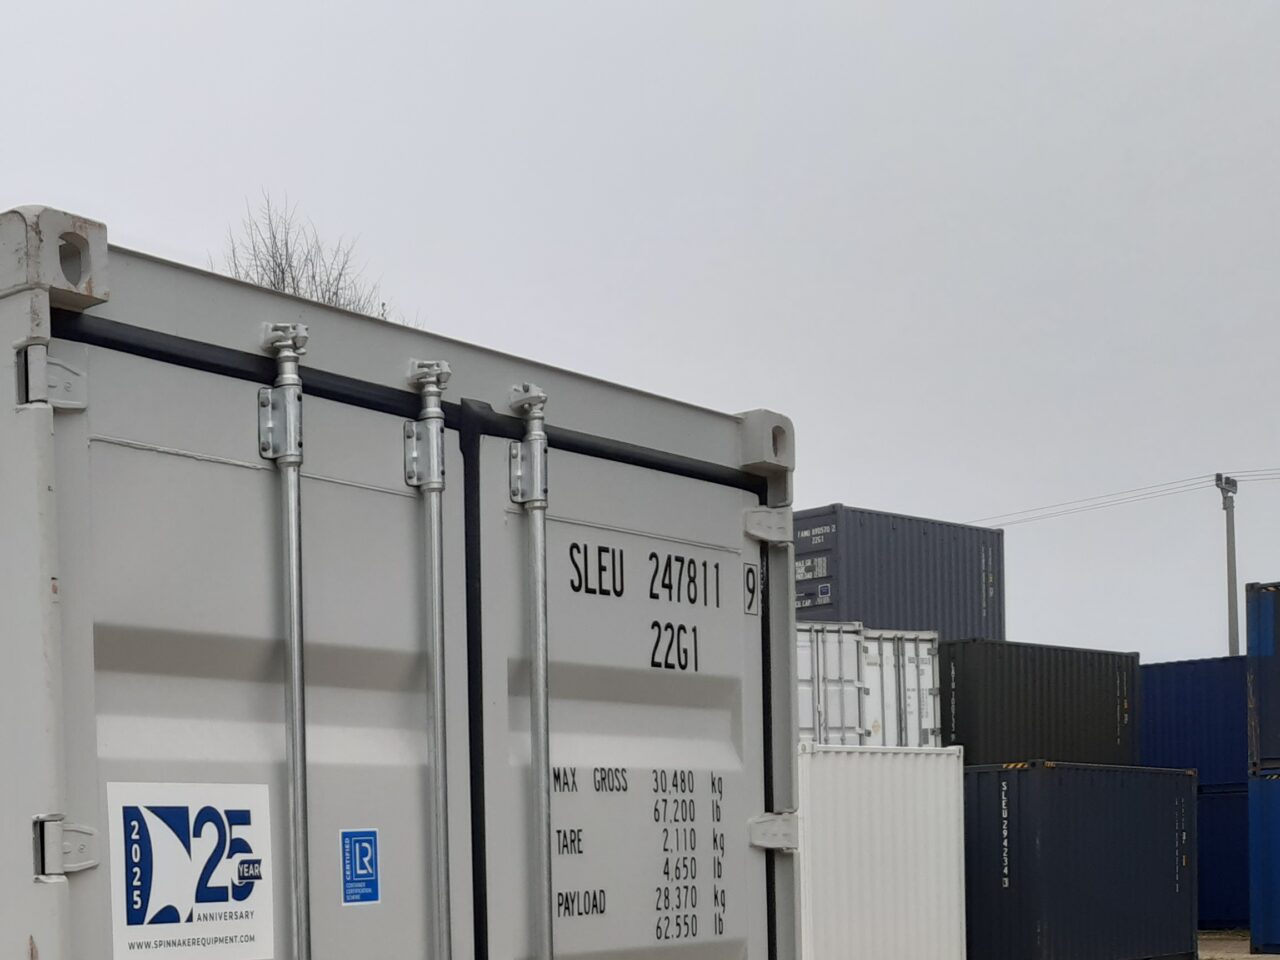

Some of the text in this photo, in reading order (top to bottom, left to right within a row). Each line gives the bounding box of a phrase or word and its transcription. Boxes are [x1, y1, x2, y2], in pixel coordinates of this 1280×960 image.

[570, 542, 624, 598] SLEU
[649, 552, 720, 608] 247811
[745, 566, 757, 613] 9
[650, 619, 699, 672] 22G1
[553, 767, 578, 792] MAX
[593, 767, 628, 792] GROSS
[710, 771, 723, 801] kg
[1001, 780, 1009, 818] SLEU
[712, 799, 721, 823] lb
[192, 806, 256, 903] 25
[355, 842, 373, 874] LR
[556, 829, 583, 855] TARE
[713, 827, 725, 858] kg
[130, 820, 142, 910] 2025
[239, 863, 260, 877] YEAR
[713, 856, 722, 880] lb
[196, 911, 255, 922] ANNIVERSARY
[557, 889, 606, 918] PAYLOAD
[713, 884, 726, 914] kg
[714, 912, 724, 936] lb
[127, 934, 255, 950] WWW.SPINNAKEREQUIPMENT.COM
